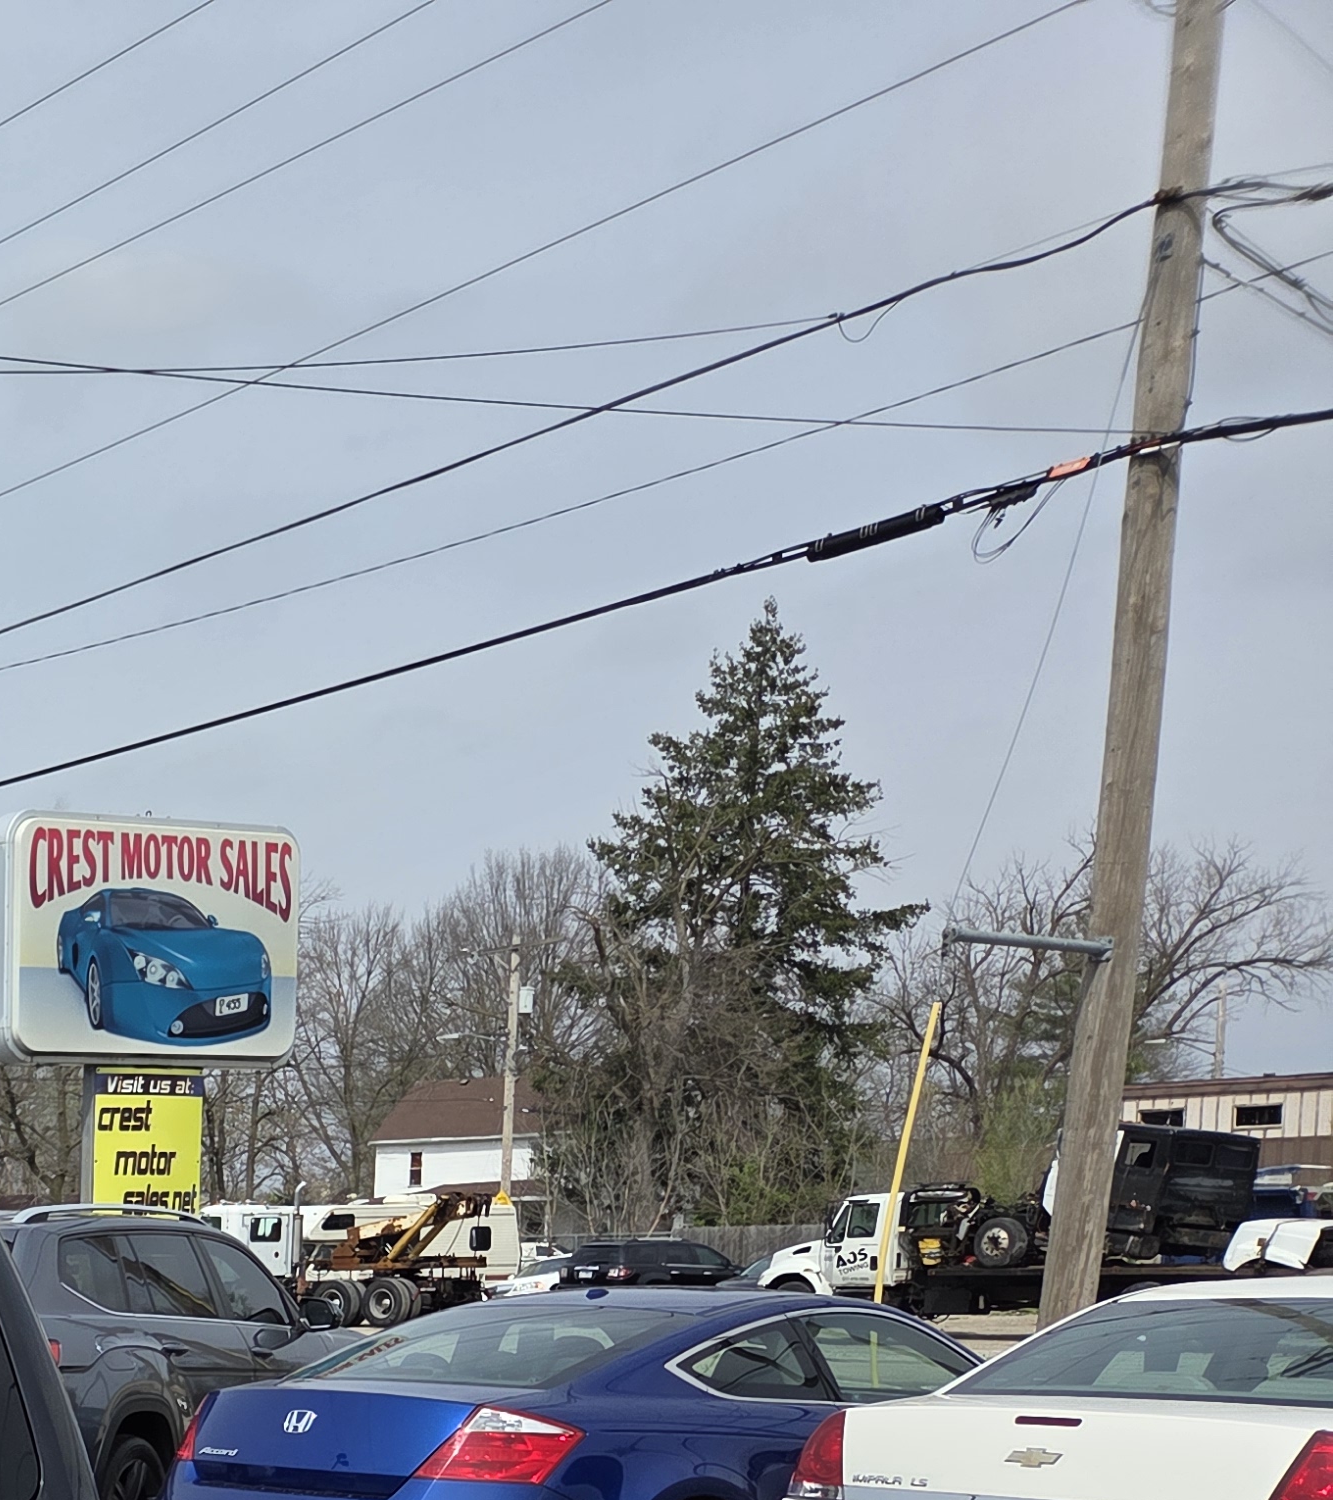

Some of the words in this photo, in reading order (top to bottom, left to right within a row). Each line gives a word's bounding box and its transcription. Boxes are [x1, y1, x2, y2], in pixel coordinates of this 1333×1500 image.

[29, 826, 115, 909] CREST
[121, 832, 213, 886] MOTOR
[220, 838, 292, 923] SALES
[107, 1076, 145, 1094] Visit
[149, 1079, 171, 1094] us
[97, 1100, 153, 1132] crest
[114, 1144, 176, 1176] motor
[836, 1247, 868, 1268] AJS
[838, 1261, 869, 1275] TOWING
[198, 1446, 239, 1457] Accord
[852, 1474, 903, 1486] IMPALA
[910, 1477, 928, 1487] LS
